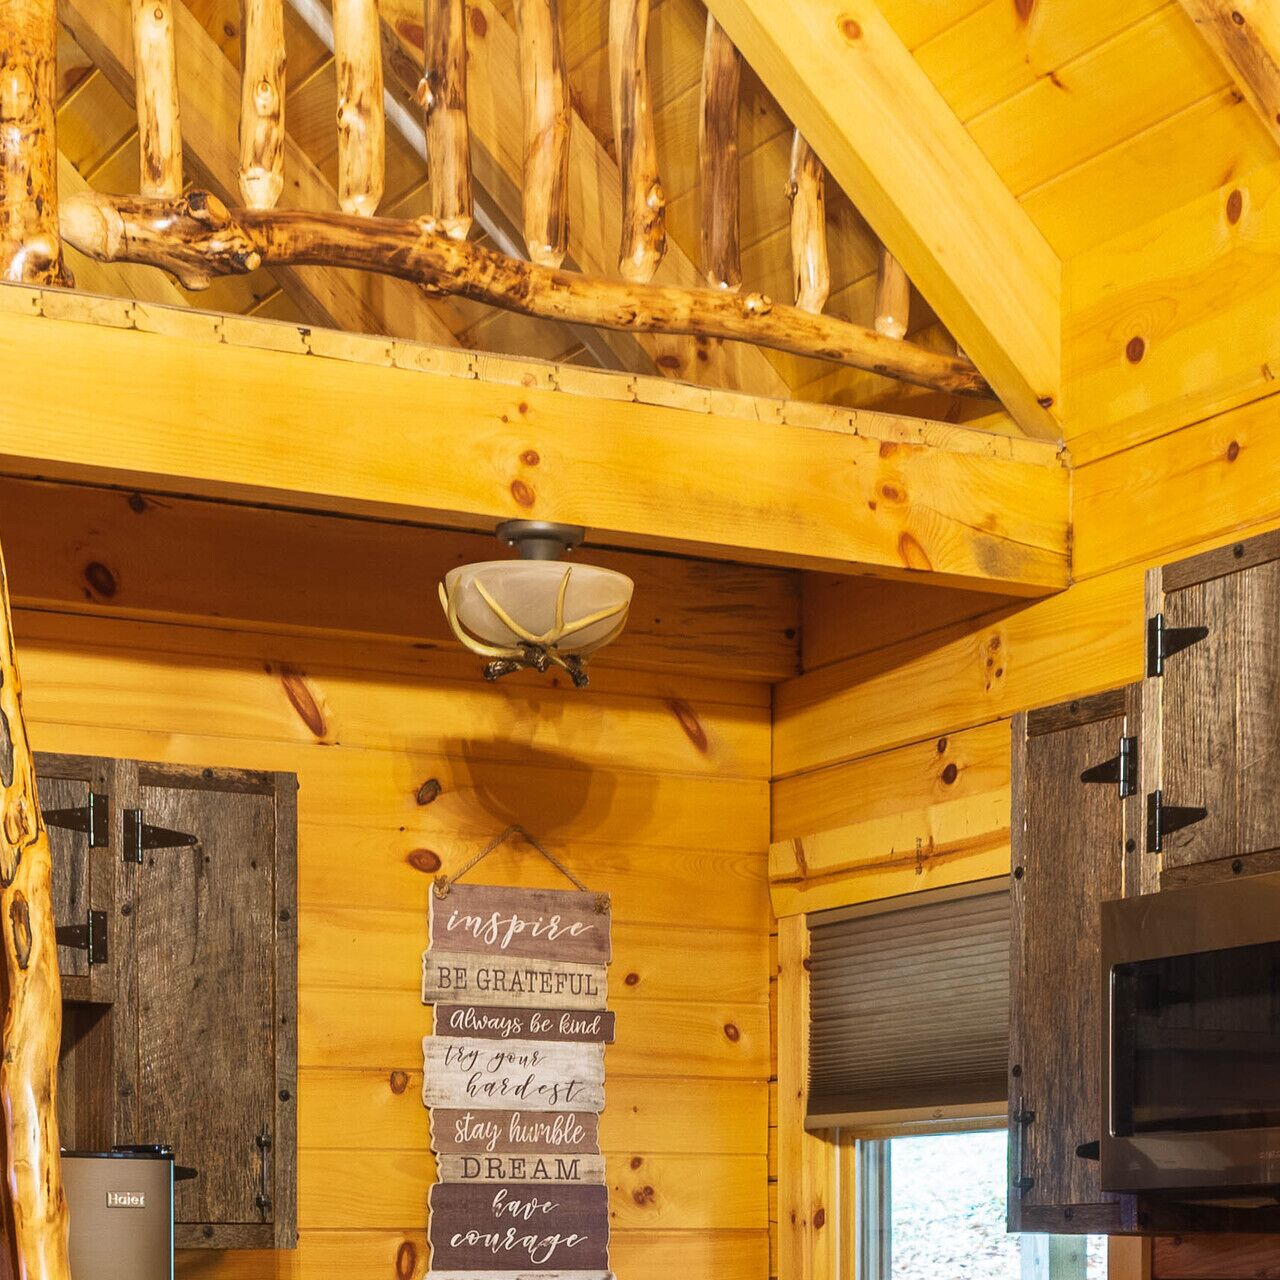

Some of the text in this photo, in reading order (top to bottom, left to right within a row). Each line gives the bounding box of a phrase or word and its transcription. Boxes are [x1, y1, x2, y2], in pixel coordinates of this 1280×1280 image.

[446, 909, 594, 949] inspire
[437, 966, 599, 996] BE GRATEFUL
[449, 1007, 602, 1038] Always be kind
[444, 1045, 546, 1073] try your
[466, 1071, 586, 1105] hardest
[454, 1111, 586, 1151] stay humble
[460, 1156, 581, 1181] DREAM
[107, 1192, 145, 1206] Haier
[492, 1188, 560, 1220] have
[450, 1227, 589, 1264] courage
